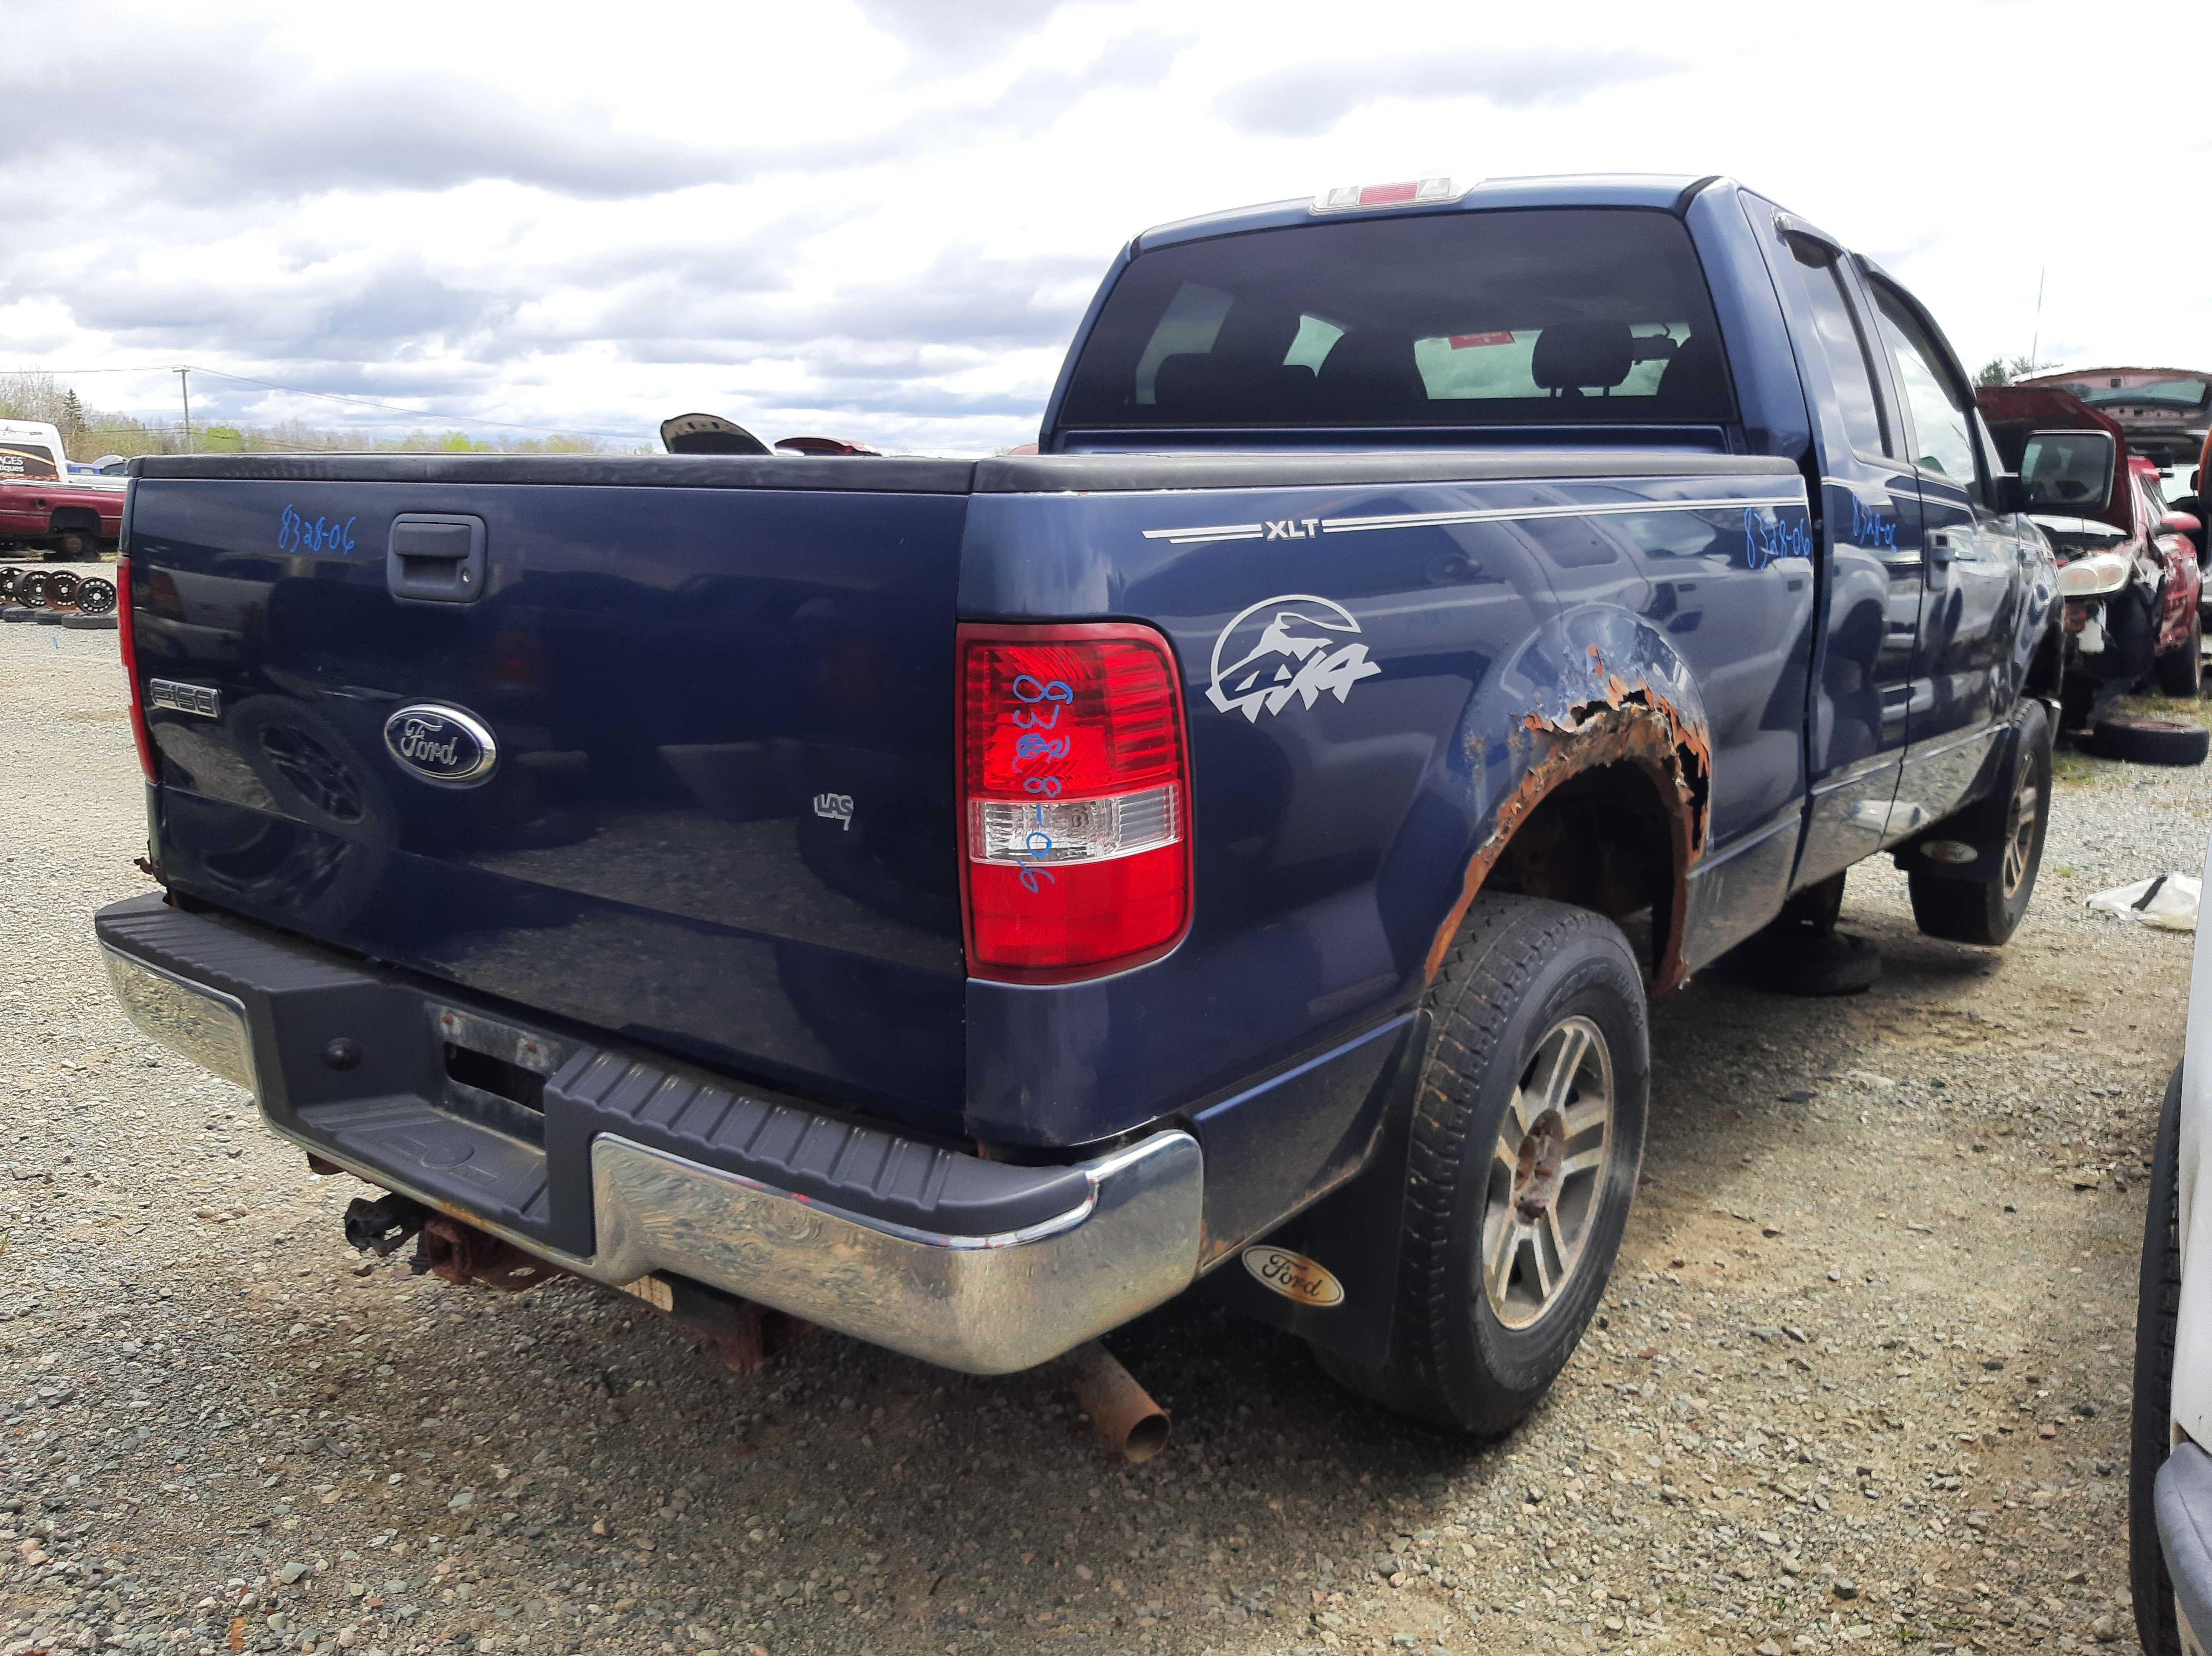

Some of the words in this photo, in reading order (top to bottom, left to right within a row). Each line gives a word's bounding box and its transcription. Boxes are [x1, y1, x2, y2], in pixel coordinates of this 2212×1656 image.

[279, 503, 356, 555] 8328-06
[1266, 518, 1319, 541] XLT
[400, 719, 458, 765] Ford
[1262, 1254, 1323, 1296] Ford
